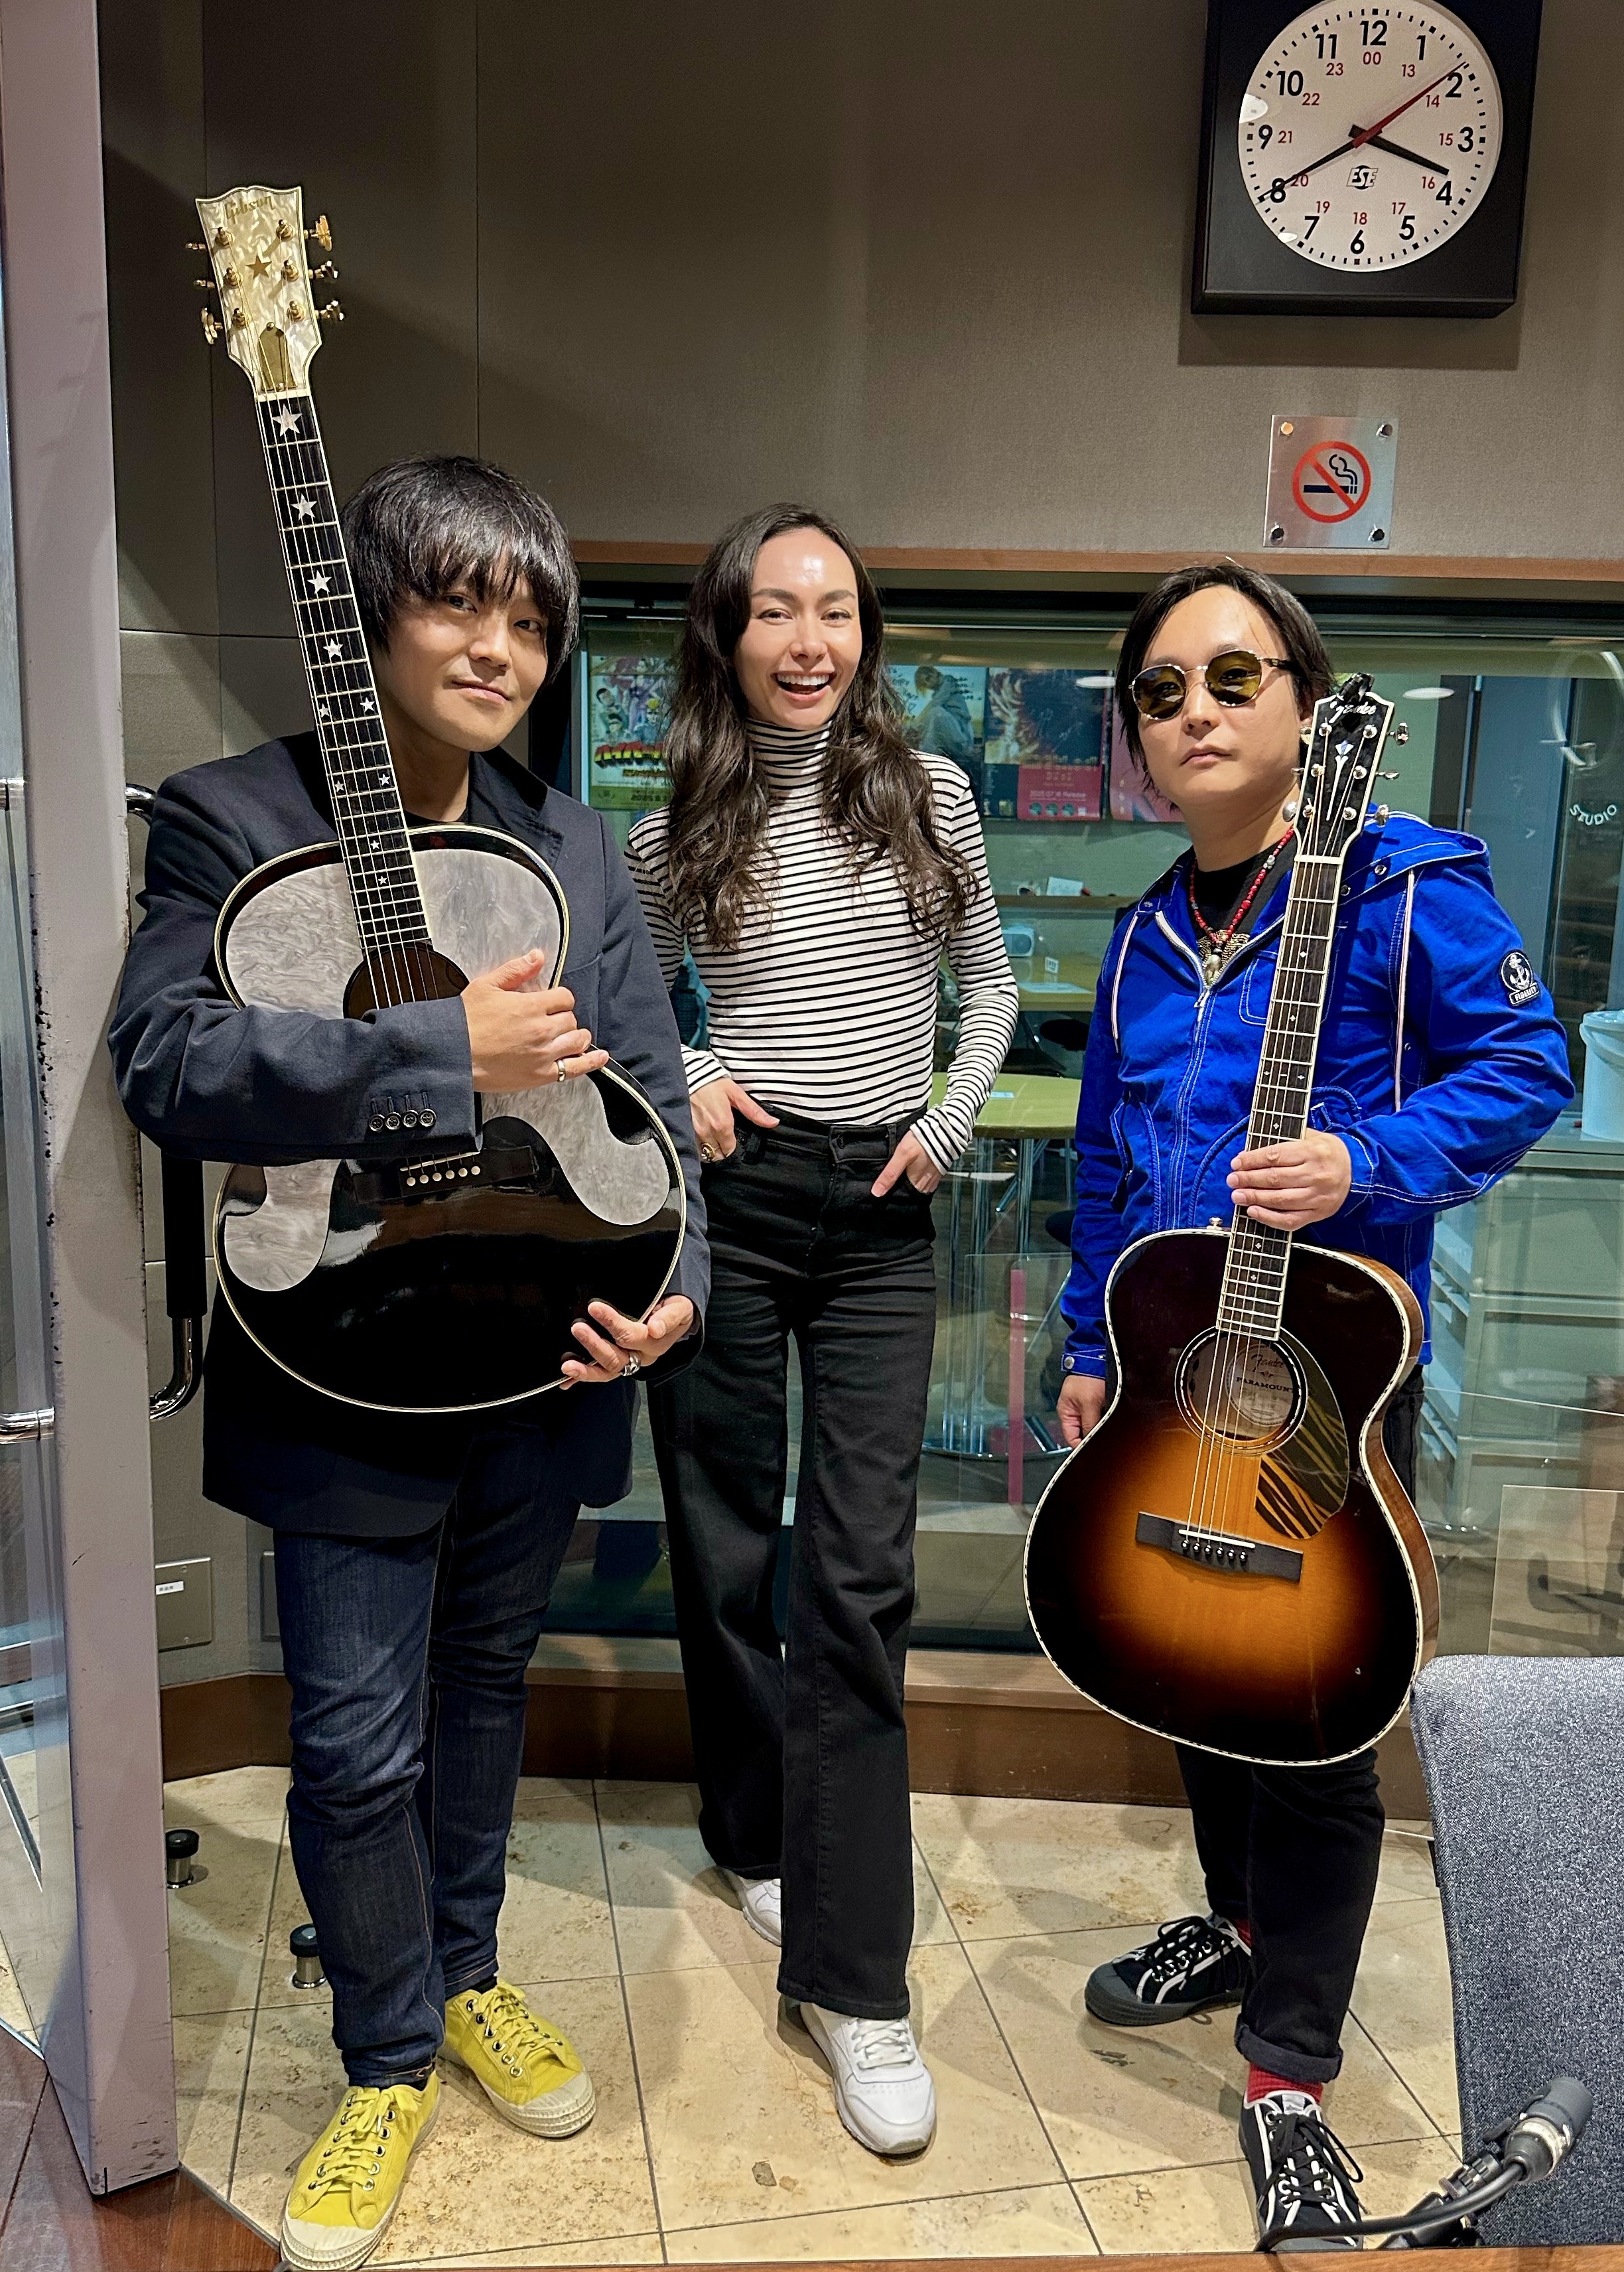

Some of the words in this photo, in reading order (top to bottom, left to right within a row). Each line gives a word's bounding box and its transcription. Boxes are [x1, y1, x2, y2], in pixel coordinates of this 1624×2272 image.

[1359, 20, 1388, 46] 12
[1315, 33, 1337, 60] 11
[1363, 52, 1381, 65] 00
[1416, 35, 1426, 60] 1
[1325, 62, 1344, 76] 23
[1401, 64, 1416, 78] 13
[1276, 70, 1304, 97] 10
[1445, 72, 1463, 98] 2
[1302, 92, 1320, 106] 22
[1426, 94, 1440, 108] 14
[1258, 124, 1273, 150] 9
[1278, 130, 1293, 143] 21
[1439, 133, 1454, 146] 15
[1457, 126, 1474, 153] 3
[1347, 165, 1379, 190] ESE
[1421, 176, 1435, 190] 16
[1270, 177, 1286, 204] 8
[1436, 180, 1452, 206] 4
[224, 196, 275, 225] Gibson
[1316, 200, 1330, 214] 19
[1353, 212, 1367, 225] 18
[1391, 202, 1406, 215] 17
[1304, 216, 1320, 240] 7
[1398, 215, 1416, 240] 5
[1350, 230, 1365, 255] 6
[1569, 804, 1617, 825] STUDIO
[1251, 1354, 1285, 1372] Fender
